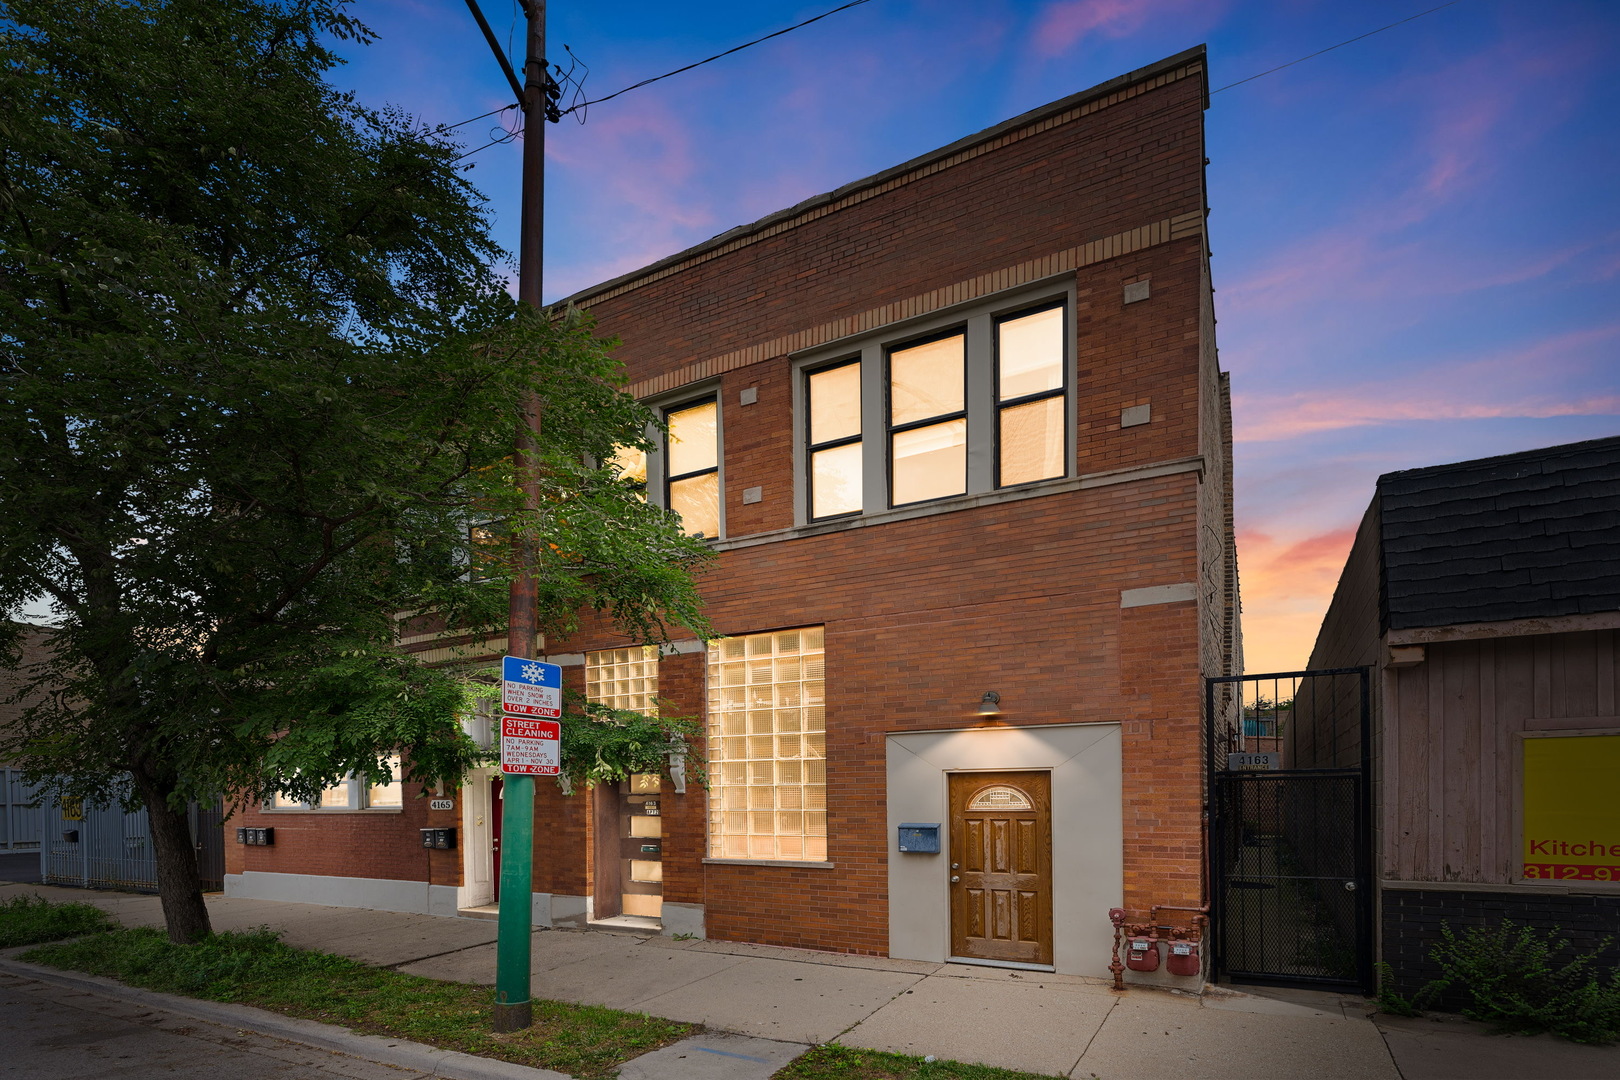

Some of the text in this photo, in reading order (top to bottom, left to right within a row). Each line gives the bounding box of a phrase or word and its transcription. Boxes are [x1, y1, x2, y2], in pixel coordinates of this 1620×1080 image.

[519, 684, 544, 693] PARKING
[533, 699, 554, 707] INCHES
[507, 703, 556, 717] TOW ZONE
[506, 719, 541, 730] STREET
[505, 728, 554, 739] CLEANING
[506, 751, 548, 759] WEDNESDAYS
[1239, 755, 1269, 765] 4163
[531, 766, 556, 774] ZONE
[431, 801, 451, 809] 4165
[1530, 839, 1620, 857] Kitche
